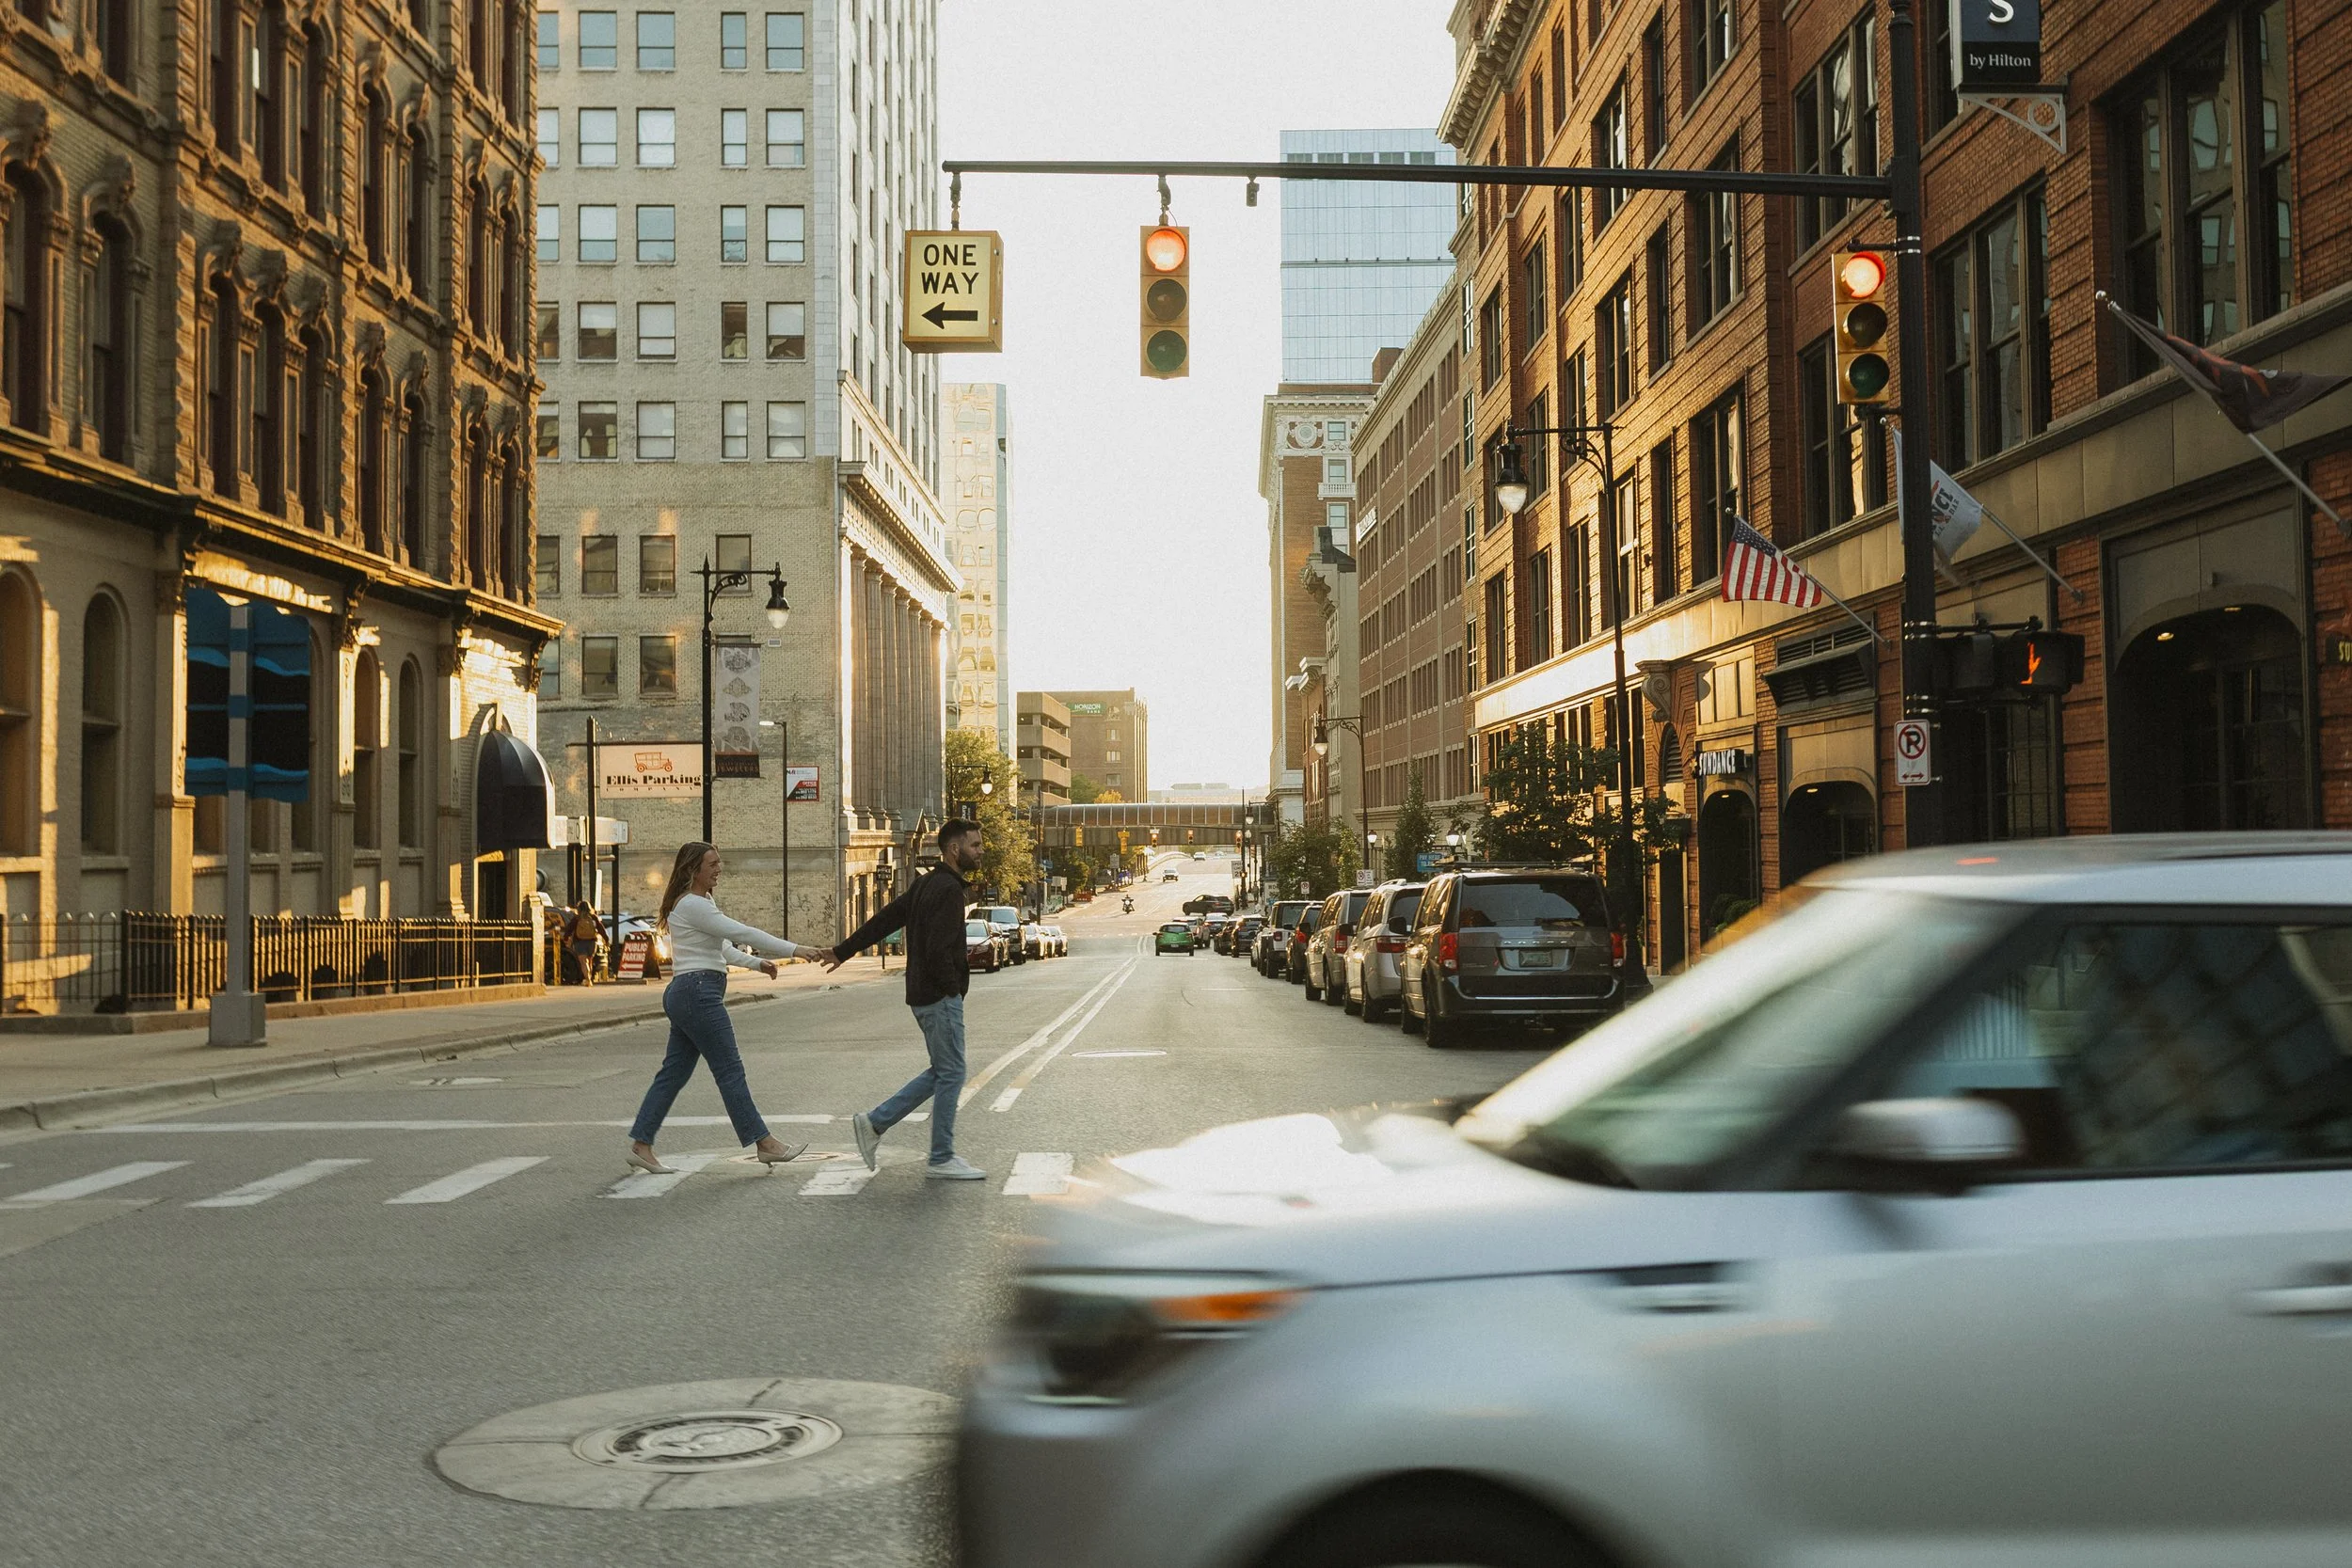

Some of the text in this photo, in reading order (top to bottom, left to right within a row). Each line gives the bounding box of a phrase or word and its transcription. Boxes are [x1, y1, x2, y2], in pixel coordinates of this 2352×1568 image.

[1969, 54, 2031, 70] by Hilton
[923, 244, 977, 266] ONE
[921, 272, 979, 294] WAY
[1699, 749, 1736, 776] SUNDANCE
[607, 774, 702, 787] Ellis Parking
[625, 942, 648, 952] PUBLIC
[623, 952, 646, 961] PARKING
